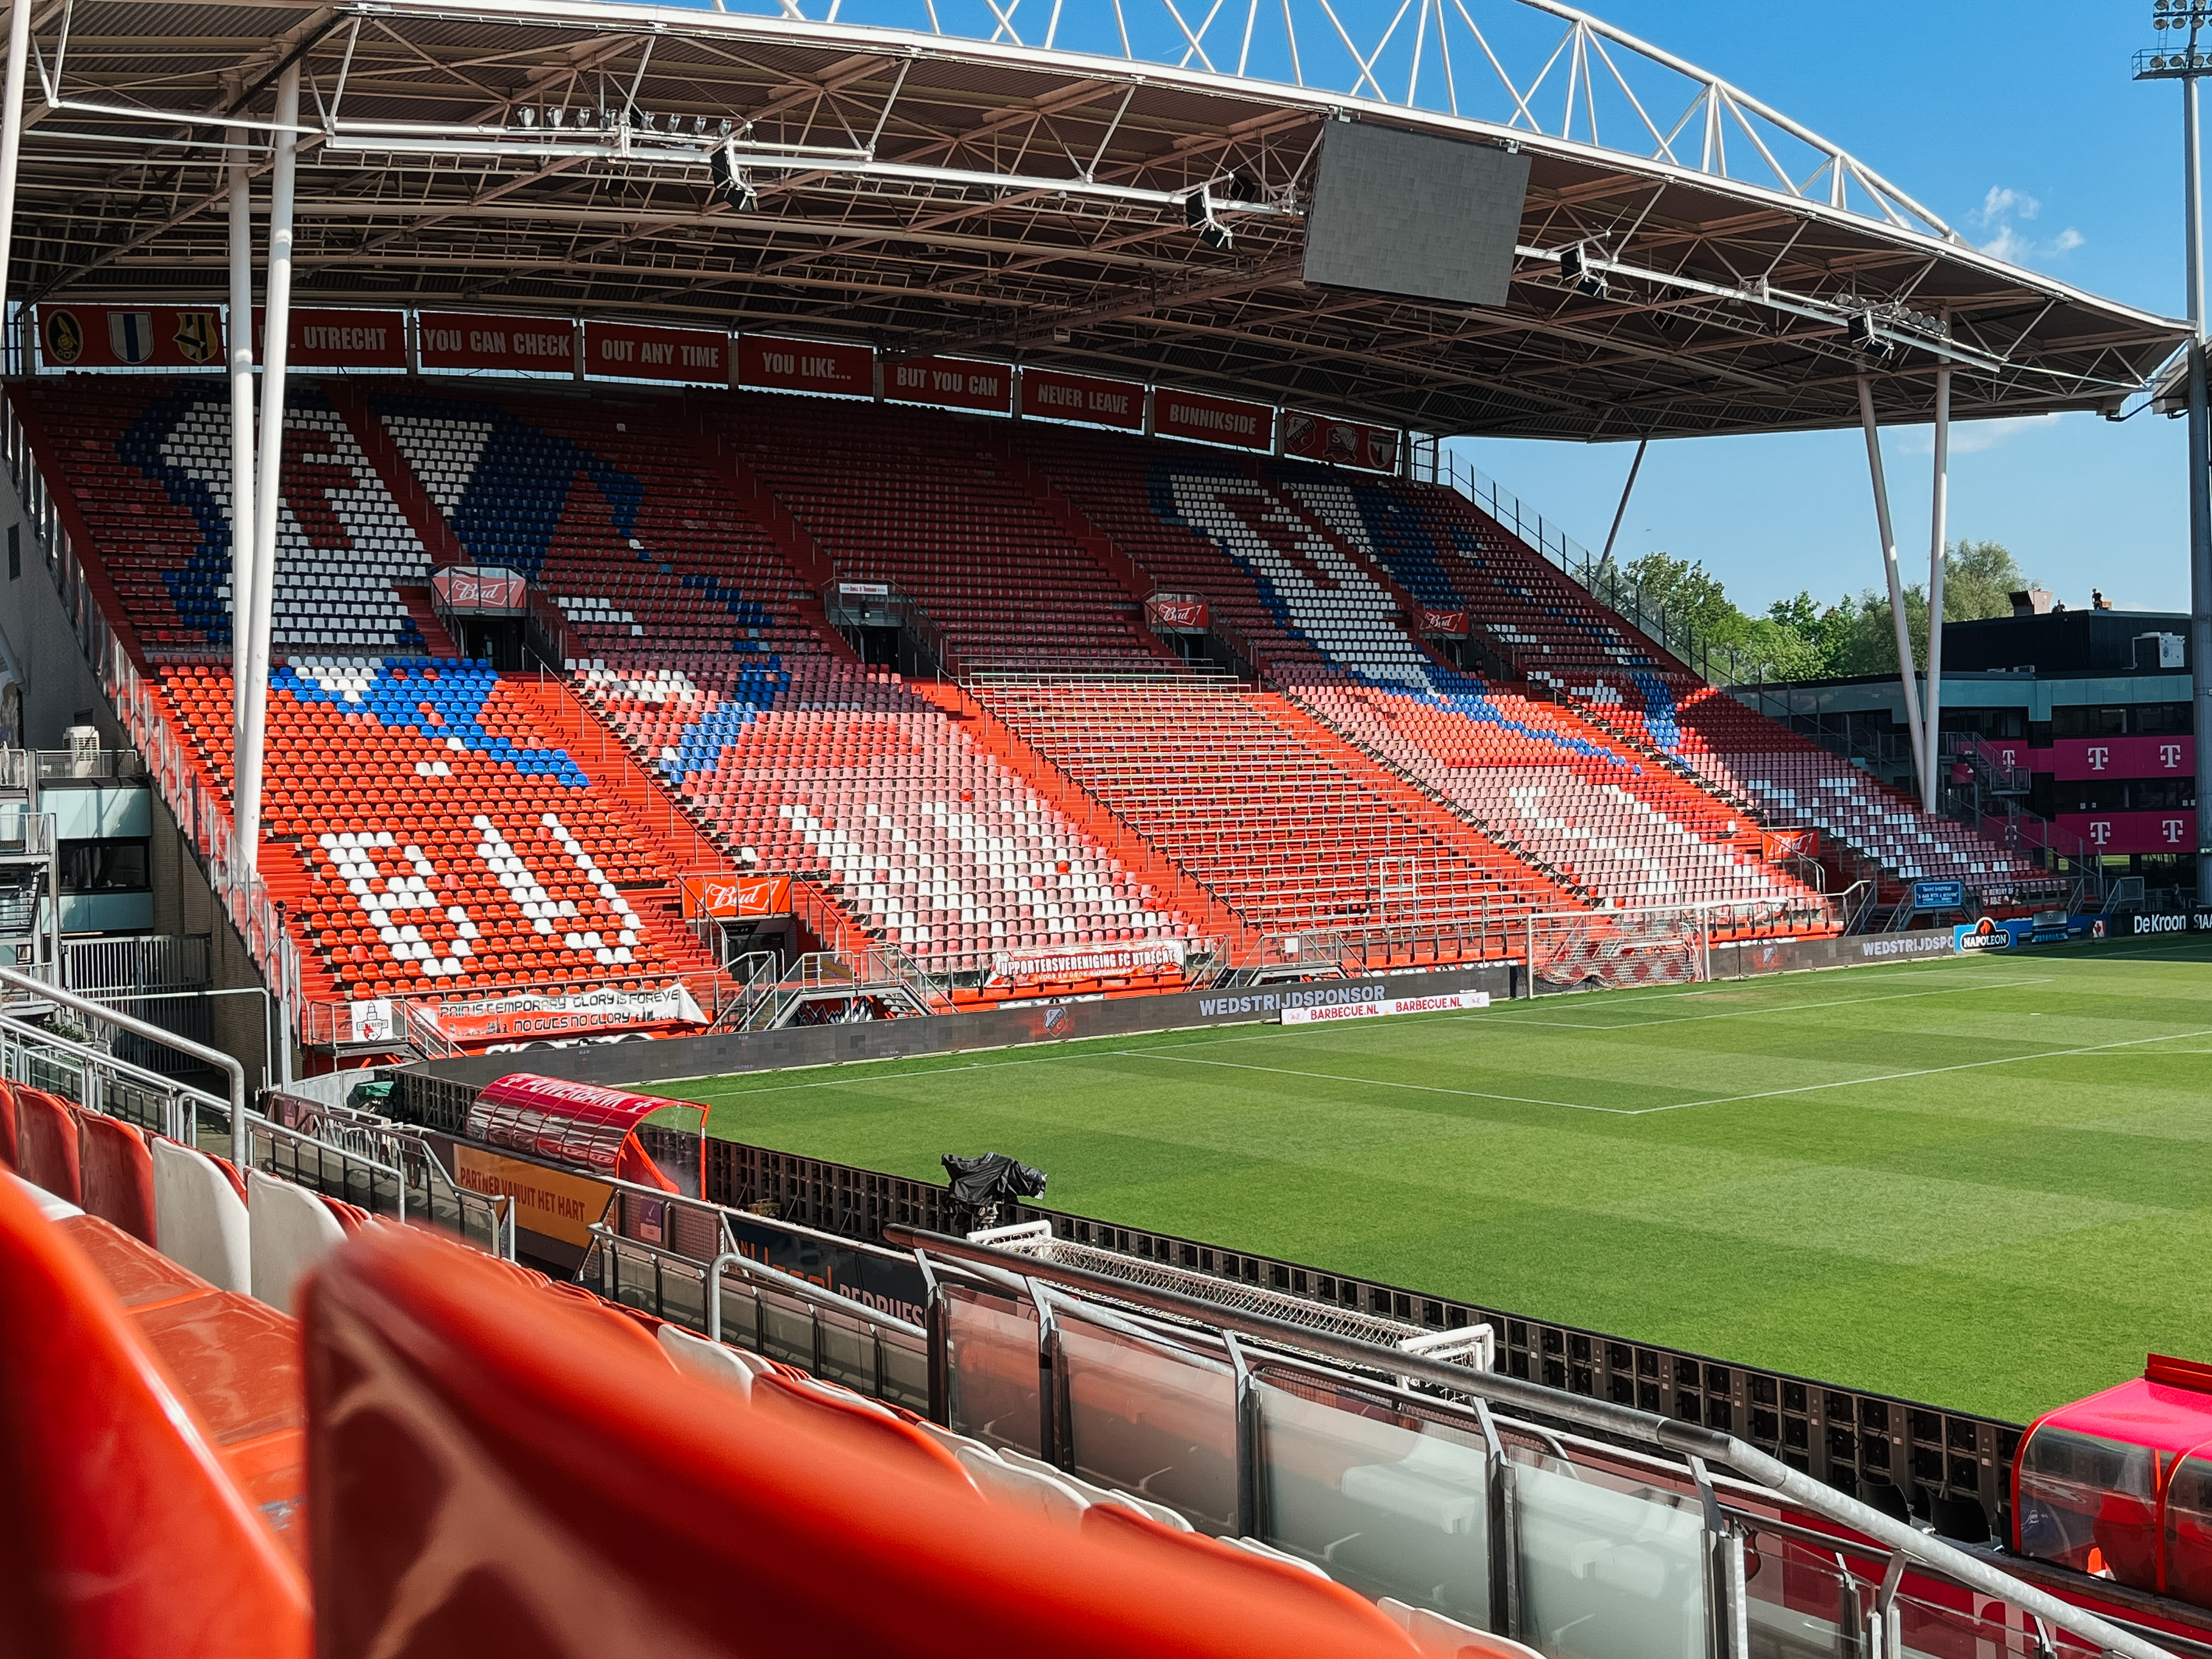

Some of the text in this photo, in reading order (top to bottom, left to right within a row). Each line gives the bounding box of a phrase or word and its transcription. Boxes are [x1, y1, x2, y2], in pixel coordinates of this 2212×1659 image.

[304, 326, 386, 351] UTRECHT
[424, 329, 570, 358] YOU CAN CHECK
[602, 339, 719, 369] OUT ANY TIME
[763, 352, 851, 381] YOU LIKE...
[897, 367, 998, 397] BUT YOU CAN
[1037, 384, 1128, 415] NEVER LEAVE
[1169, 404, 1257, 435] BUNNIKSIDE
[456, 582, 498, 600] Bud
[1161, 606, 1189, 622] Bud
[710, 885, 758, 907] Bud
[1963, 934, 2007, 947] NAPOLEON
[1118, 952, 1131, 967] FC
[1132, 949, 1174, 966] UTRECHT
[573, 993, 614, 1008] GLORY
[617, 994, 627, 1005] IS
[1199, 985, 1385, 1016] WEDSTRIJDSPONSOR
[1310, 1005, 1379, 1020] BARBECUE.NL
[1395, 993, 1463, 1012] BARBECUE.NL
[514, 1012, 631, 1032] NO GUTS NO GLORY
[460, 1167, 585, 1222] PARTNER VANUIT HET HART
